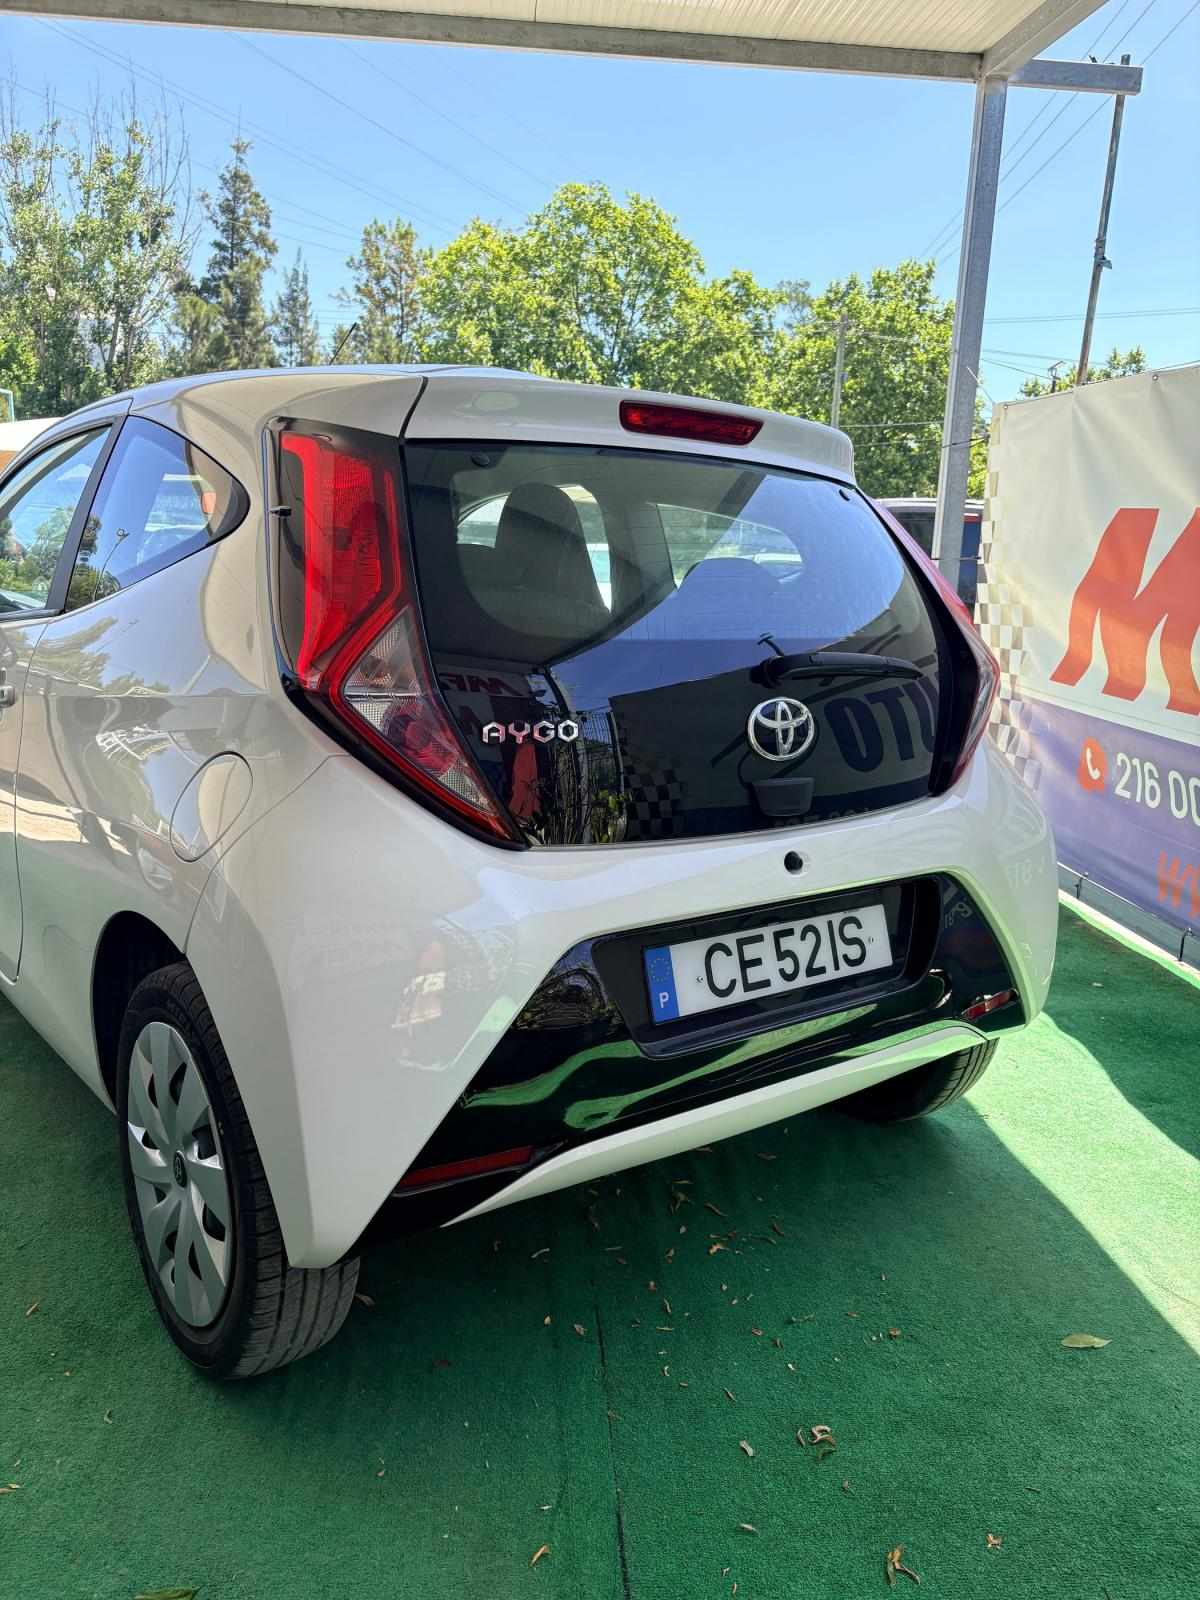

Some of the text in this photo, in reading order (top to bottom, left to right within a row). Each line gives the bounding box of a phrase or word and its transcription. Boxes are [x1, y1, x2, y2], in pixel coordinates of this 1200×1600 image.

[482, 719, 579, 744] AYGO
[1115, 753, 1161, 808] 216
[659, 992, 670, 1008] P
